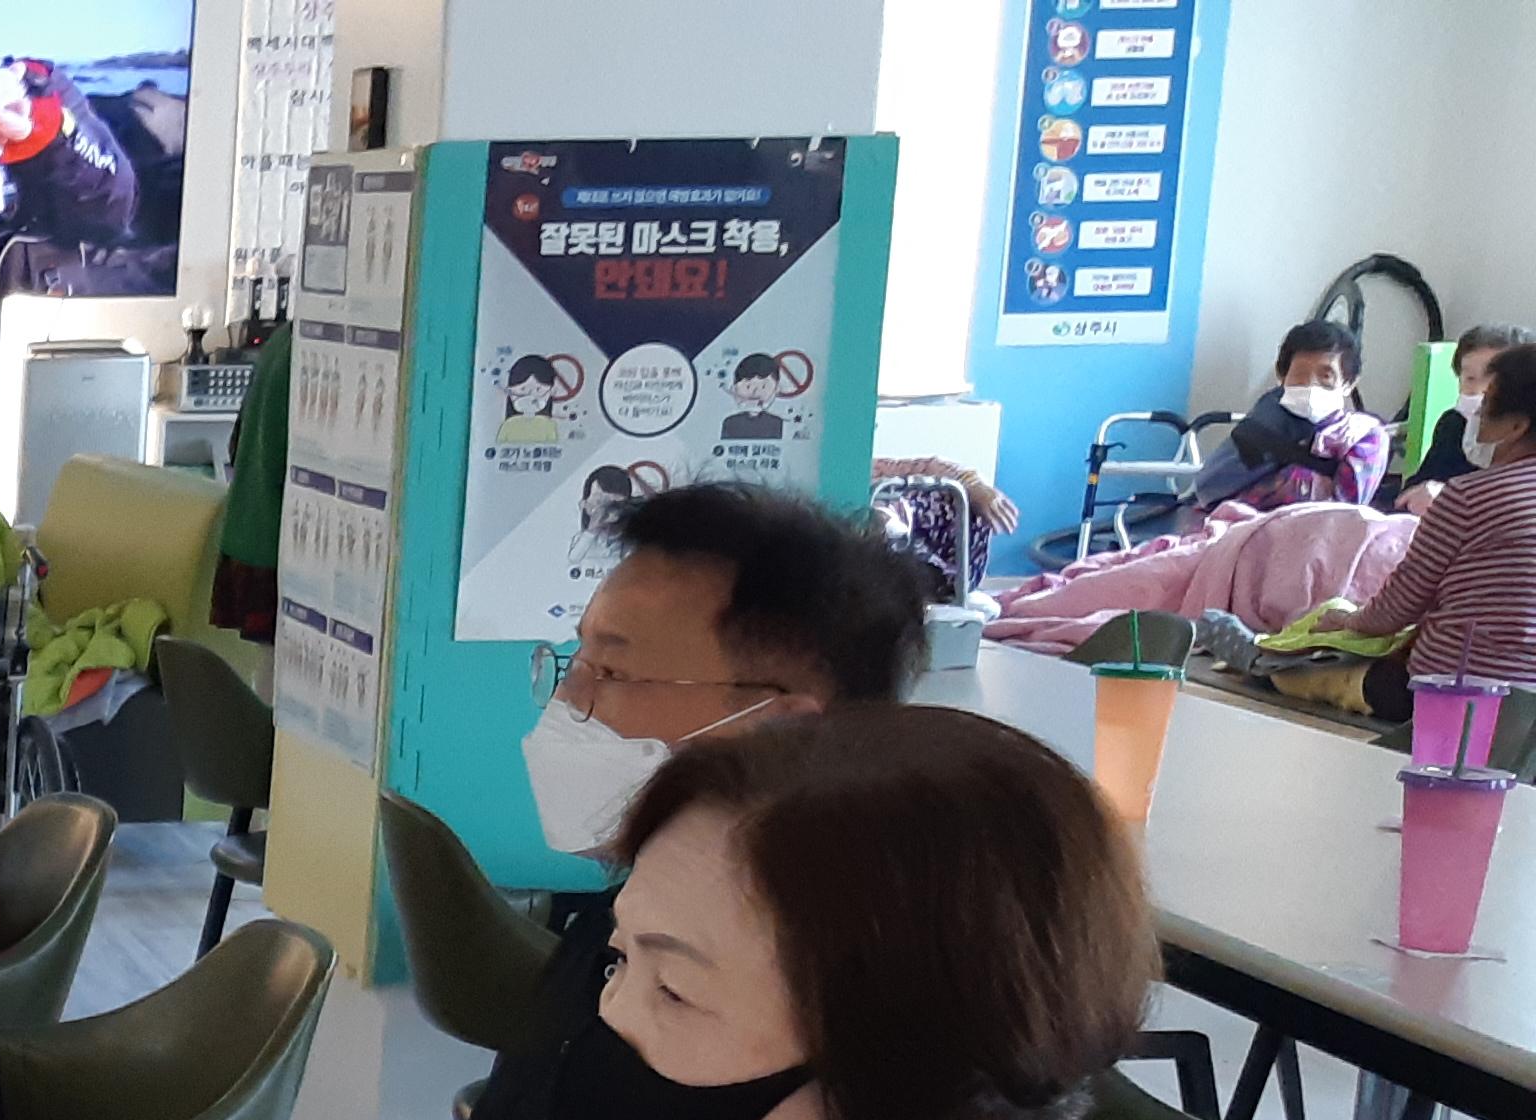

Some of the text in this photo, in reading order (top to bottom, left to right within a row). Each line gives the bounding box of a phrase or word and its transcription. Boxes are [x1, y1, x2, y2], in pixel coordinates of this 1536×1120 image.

[539, 219, 789, 256] 잘못된 마스크 착용,
[1074, 320, 1117, 336] 상주시
